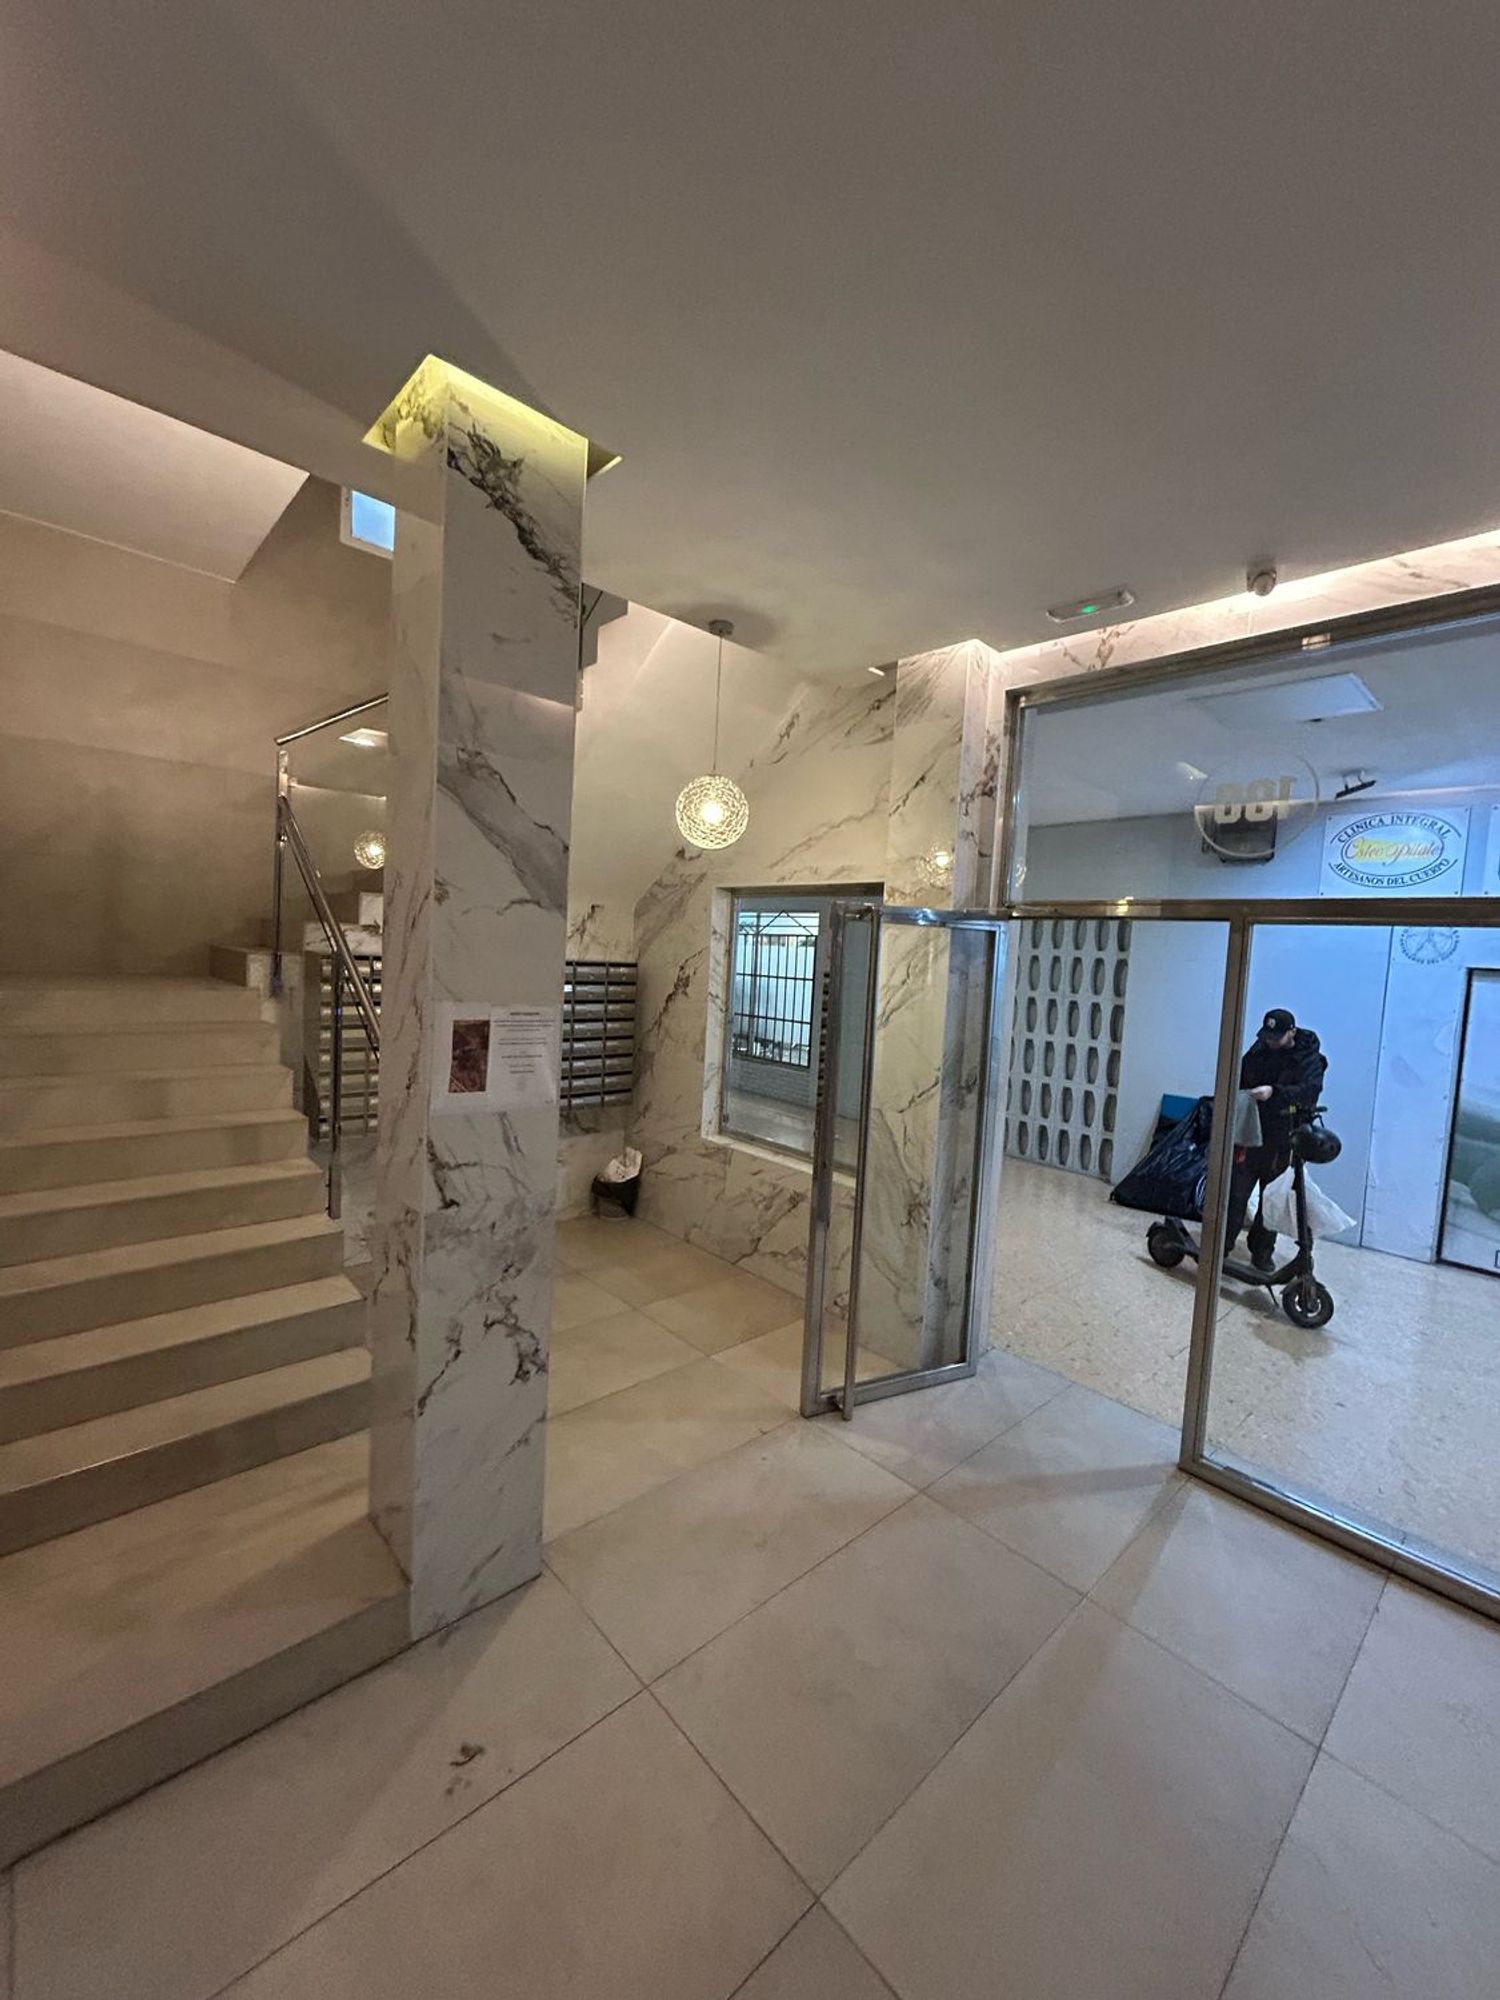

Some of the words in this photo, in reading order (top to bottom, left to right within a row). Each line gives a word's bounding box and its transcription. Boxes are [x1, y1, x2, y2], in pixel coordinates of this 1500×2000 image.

[1337, 815, 1385, 843] CLINICA
[1390, 814, 1452, 840] INTEGRAL
[1333, 862, 1385, 886] ARTESANOS
[1386, 876, 1409, 886] DEL
[1409, 858, 1450, 883] CUERPO
